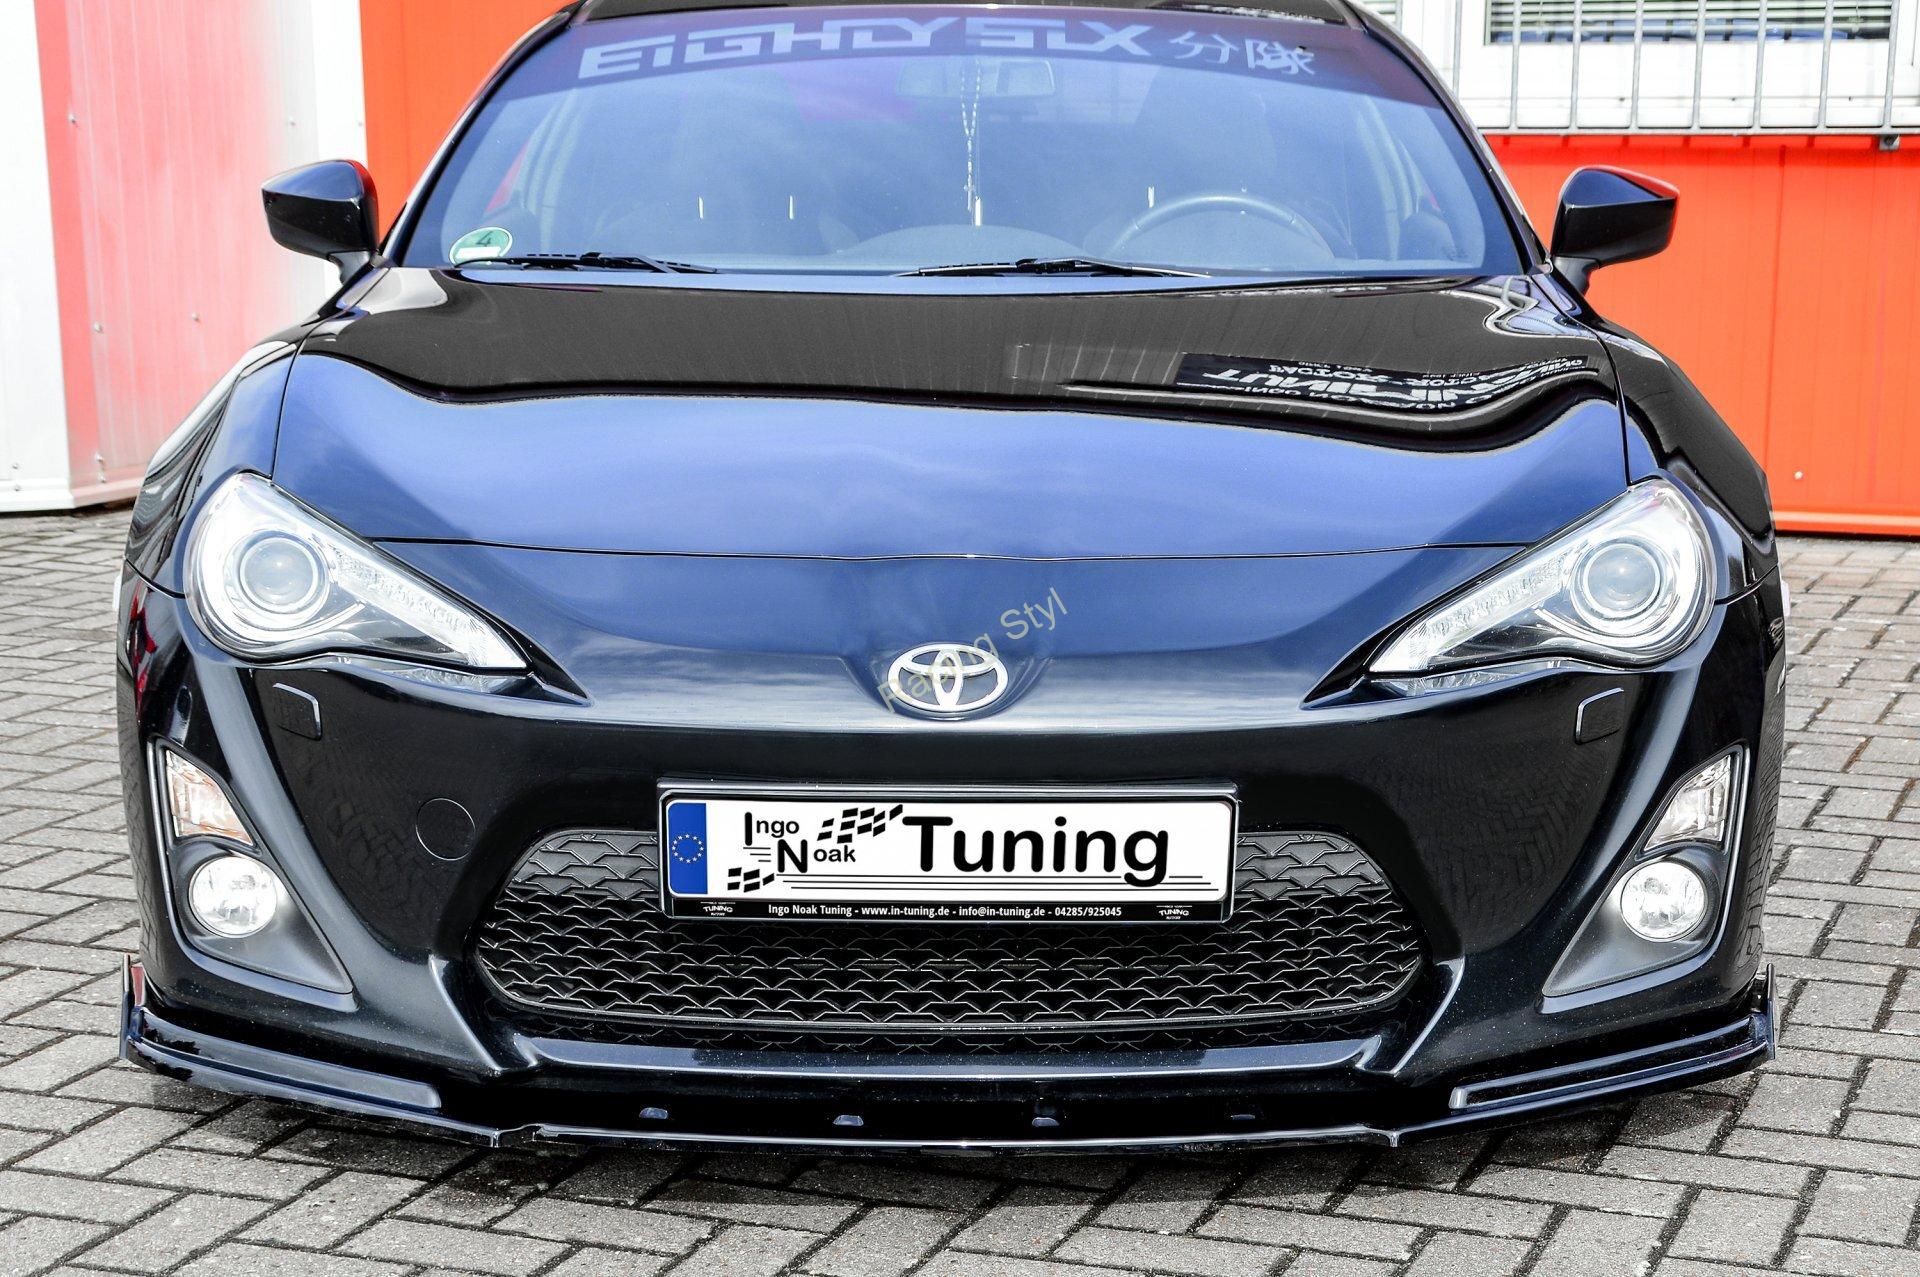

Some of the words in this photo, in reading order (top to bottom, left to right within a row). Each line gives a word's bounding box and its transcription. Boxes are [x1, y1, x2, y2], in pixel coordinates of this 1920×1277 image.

[965, 17, 1154, 57] SIX
[476, 231, 493, 247] 4
[744, 811, 800, 846] Ingo
[777, 838, 856, 874] Noak
[902, 815, 1169, 888] Tuning
[768, 904, 790, 917] Ingo
[792, 904, 818, 915] Noak
[820, 905, 852, 917] Tuning
[861, 906, 950, 918] www.in-tuning.de
[958, 906, 1046, 919] info@in-tuning.de
[1054, 907, 1122, 917] 04285/925045
